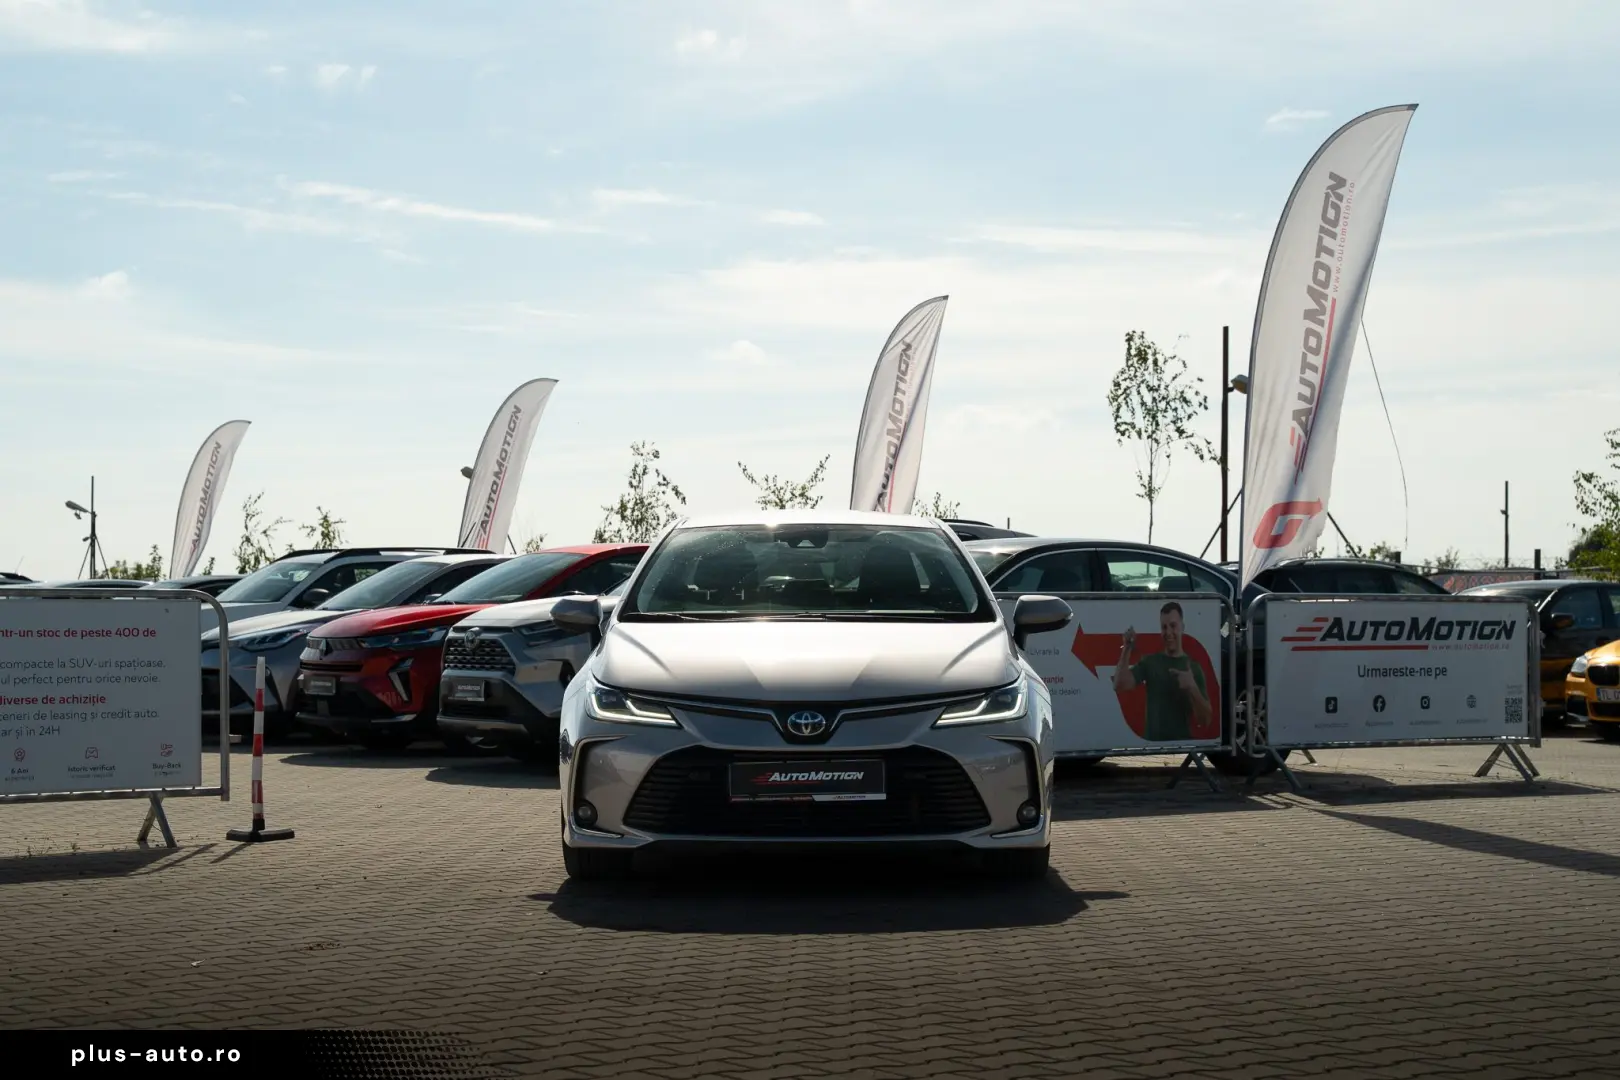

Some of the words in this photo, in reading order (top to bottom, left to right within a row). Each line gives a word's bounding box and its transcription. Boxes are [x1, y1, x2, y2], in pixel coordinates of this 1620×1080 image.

[36, 628, 61, 638] stoc
[63, 627, 78, 638] de
[80, 628, 112, 640] peste
[115, 627, 140, 638] 400
[142, 627, 157, 638] de
[57, 658, 66, 669] la
[69, 658, 112, 669] SUV-uri
[1434, 667, 1448, 680] pe
[13, 674, 54, 688] perfect
[56, 675, 93, 688] pentru
[95, 674, 121, 684] orice
[124, 673, 161, 683] nevoie.
[41, 695, 56, 705] de
[58, 693, 107, 706] achiziție
[32, 709, 48, 720] de
[50, 709, 87, 722] leasing
[100, 708, 132, 719] credit
[134, 708, 160, 718] auto.
[39, 725, 61, 736] 24H
[89, 763, 116, 772] verificat
